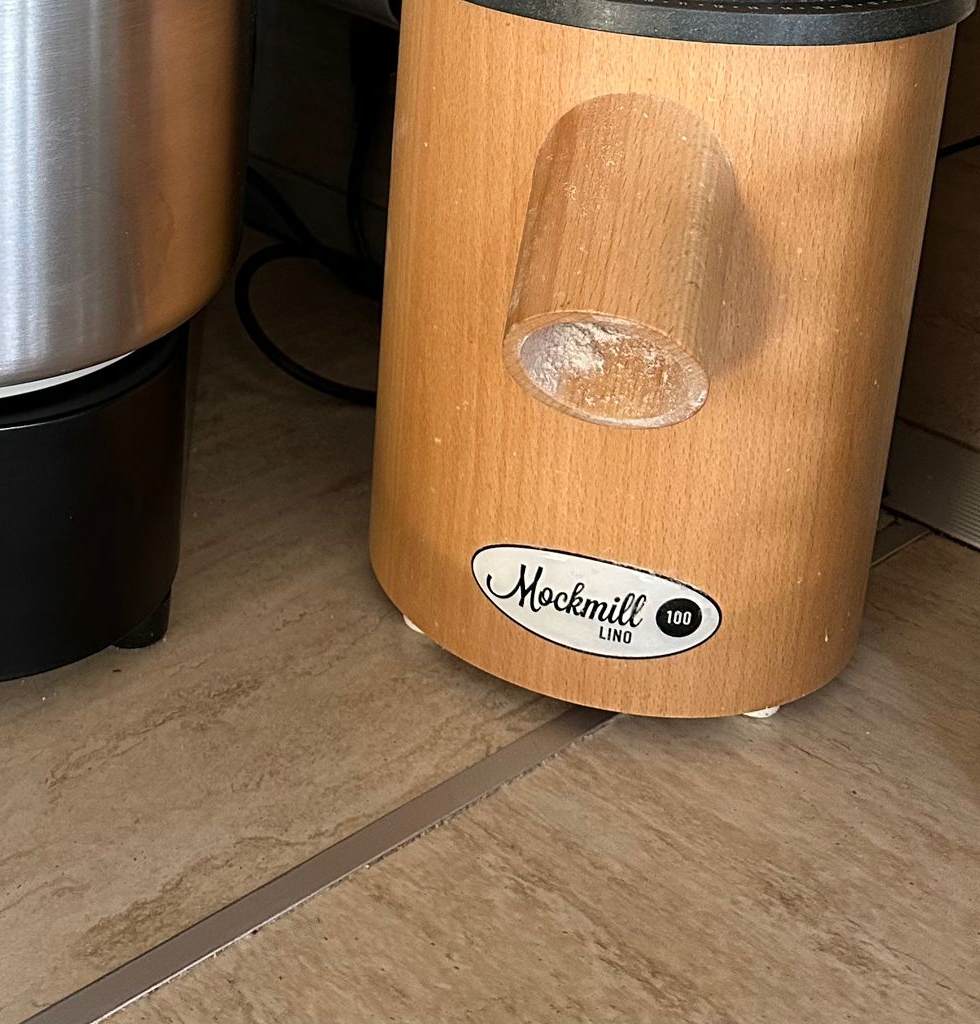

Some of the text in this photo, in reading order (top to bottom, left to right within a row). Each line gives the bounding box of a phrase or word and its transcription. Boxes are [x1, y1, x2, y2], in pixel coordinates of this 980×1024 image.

[486, 563, 647, 628] Mockmill
[665, 609, 692, 626] 100
[599, 626, 632, 644] LINO
